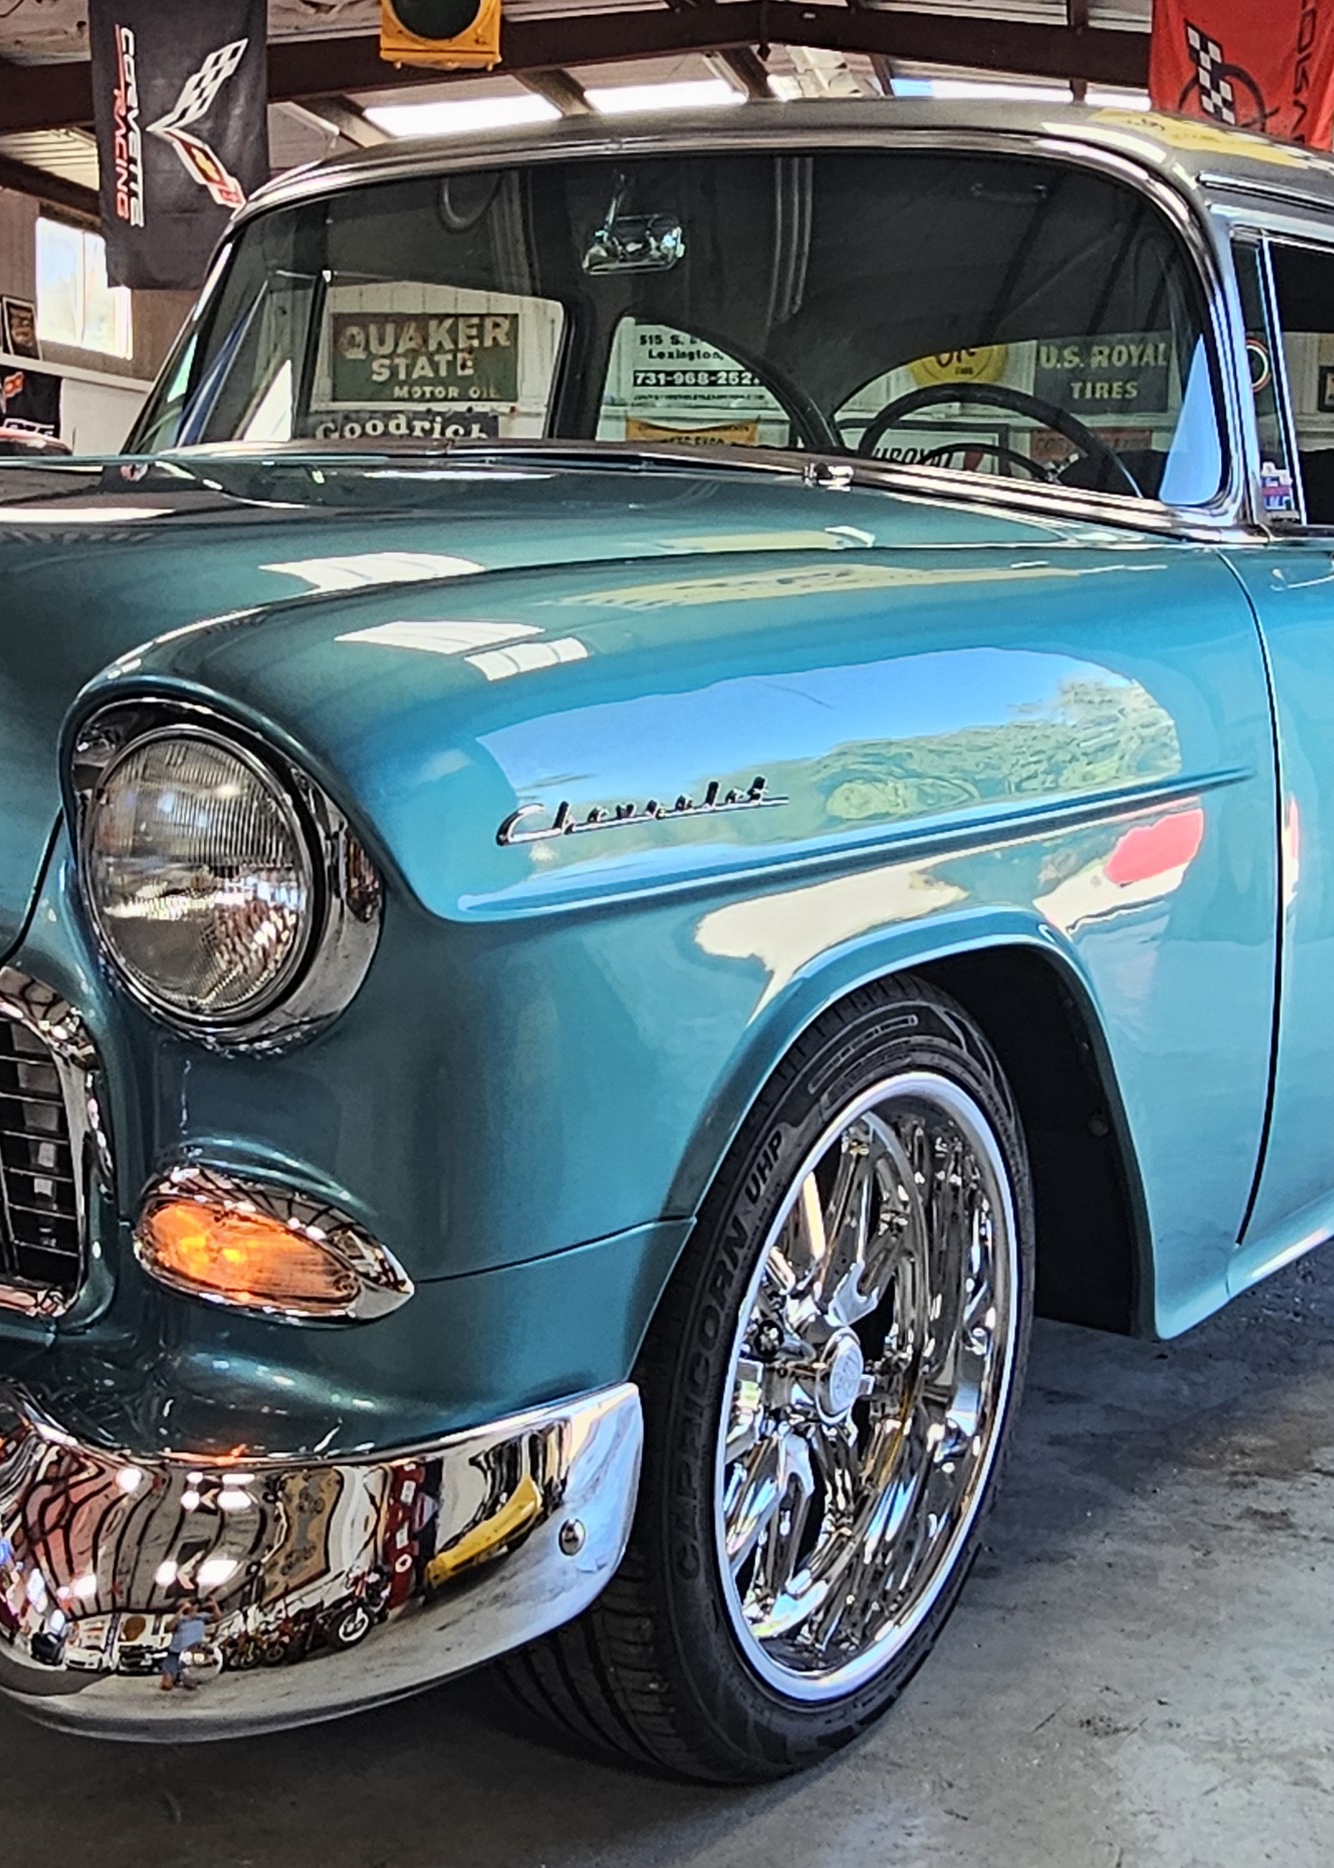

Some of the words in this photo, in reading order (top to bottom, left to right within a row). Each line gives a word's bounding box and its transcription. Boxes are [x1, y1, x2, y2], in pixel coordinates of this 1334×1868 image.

[113, 24, 130, 220] RACING
[120, 27, 144, 227] CORVETTE
[335, 316, 511, 359] QUAKER
[639, 334, 663, 346] 515
[371, 351, 475, 383] STATE
[1040, 346, 1085, 370] U.S.
[1091, 343, 1167, 368] ROYAL
[393, 385, 461, 400] MOTOR
[468, 386, 499, 400] OIL
[1070, 381, 1139, 400] TIRES
[315, 412, 490, 440] Goodrich
[495, 776, 790, 847] Chevrolet
